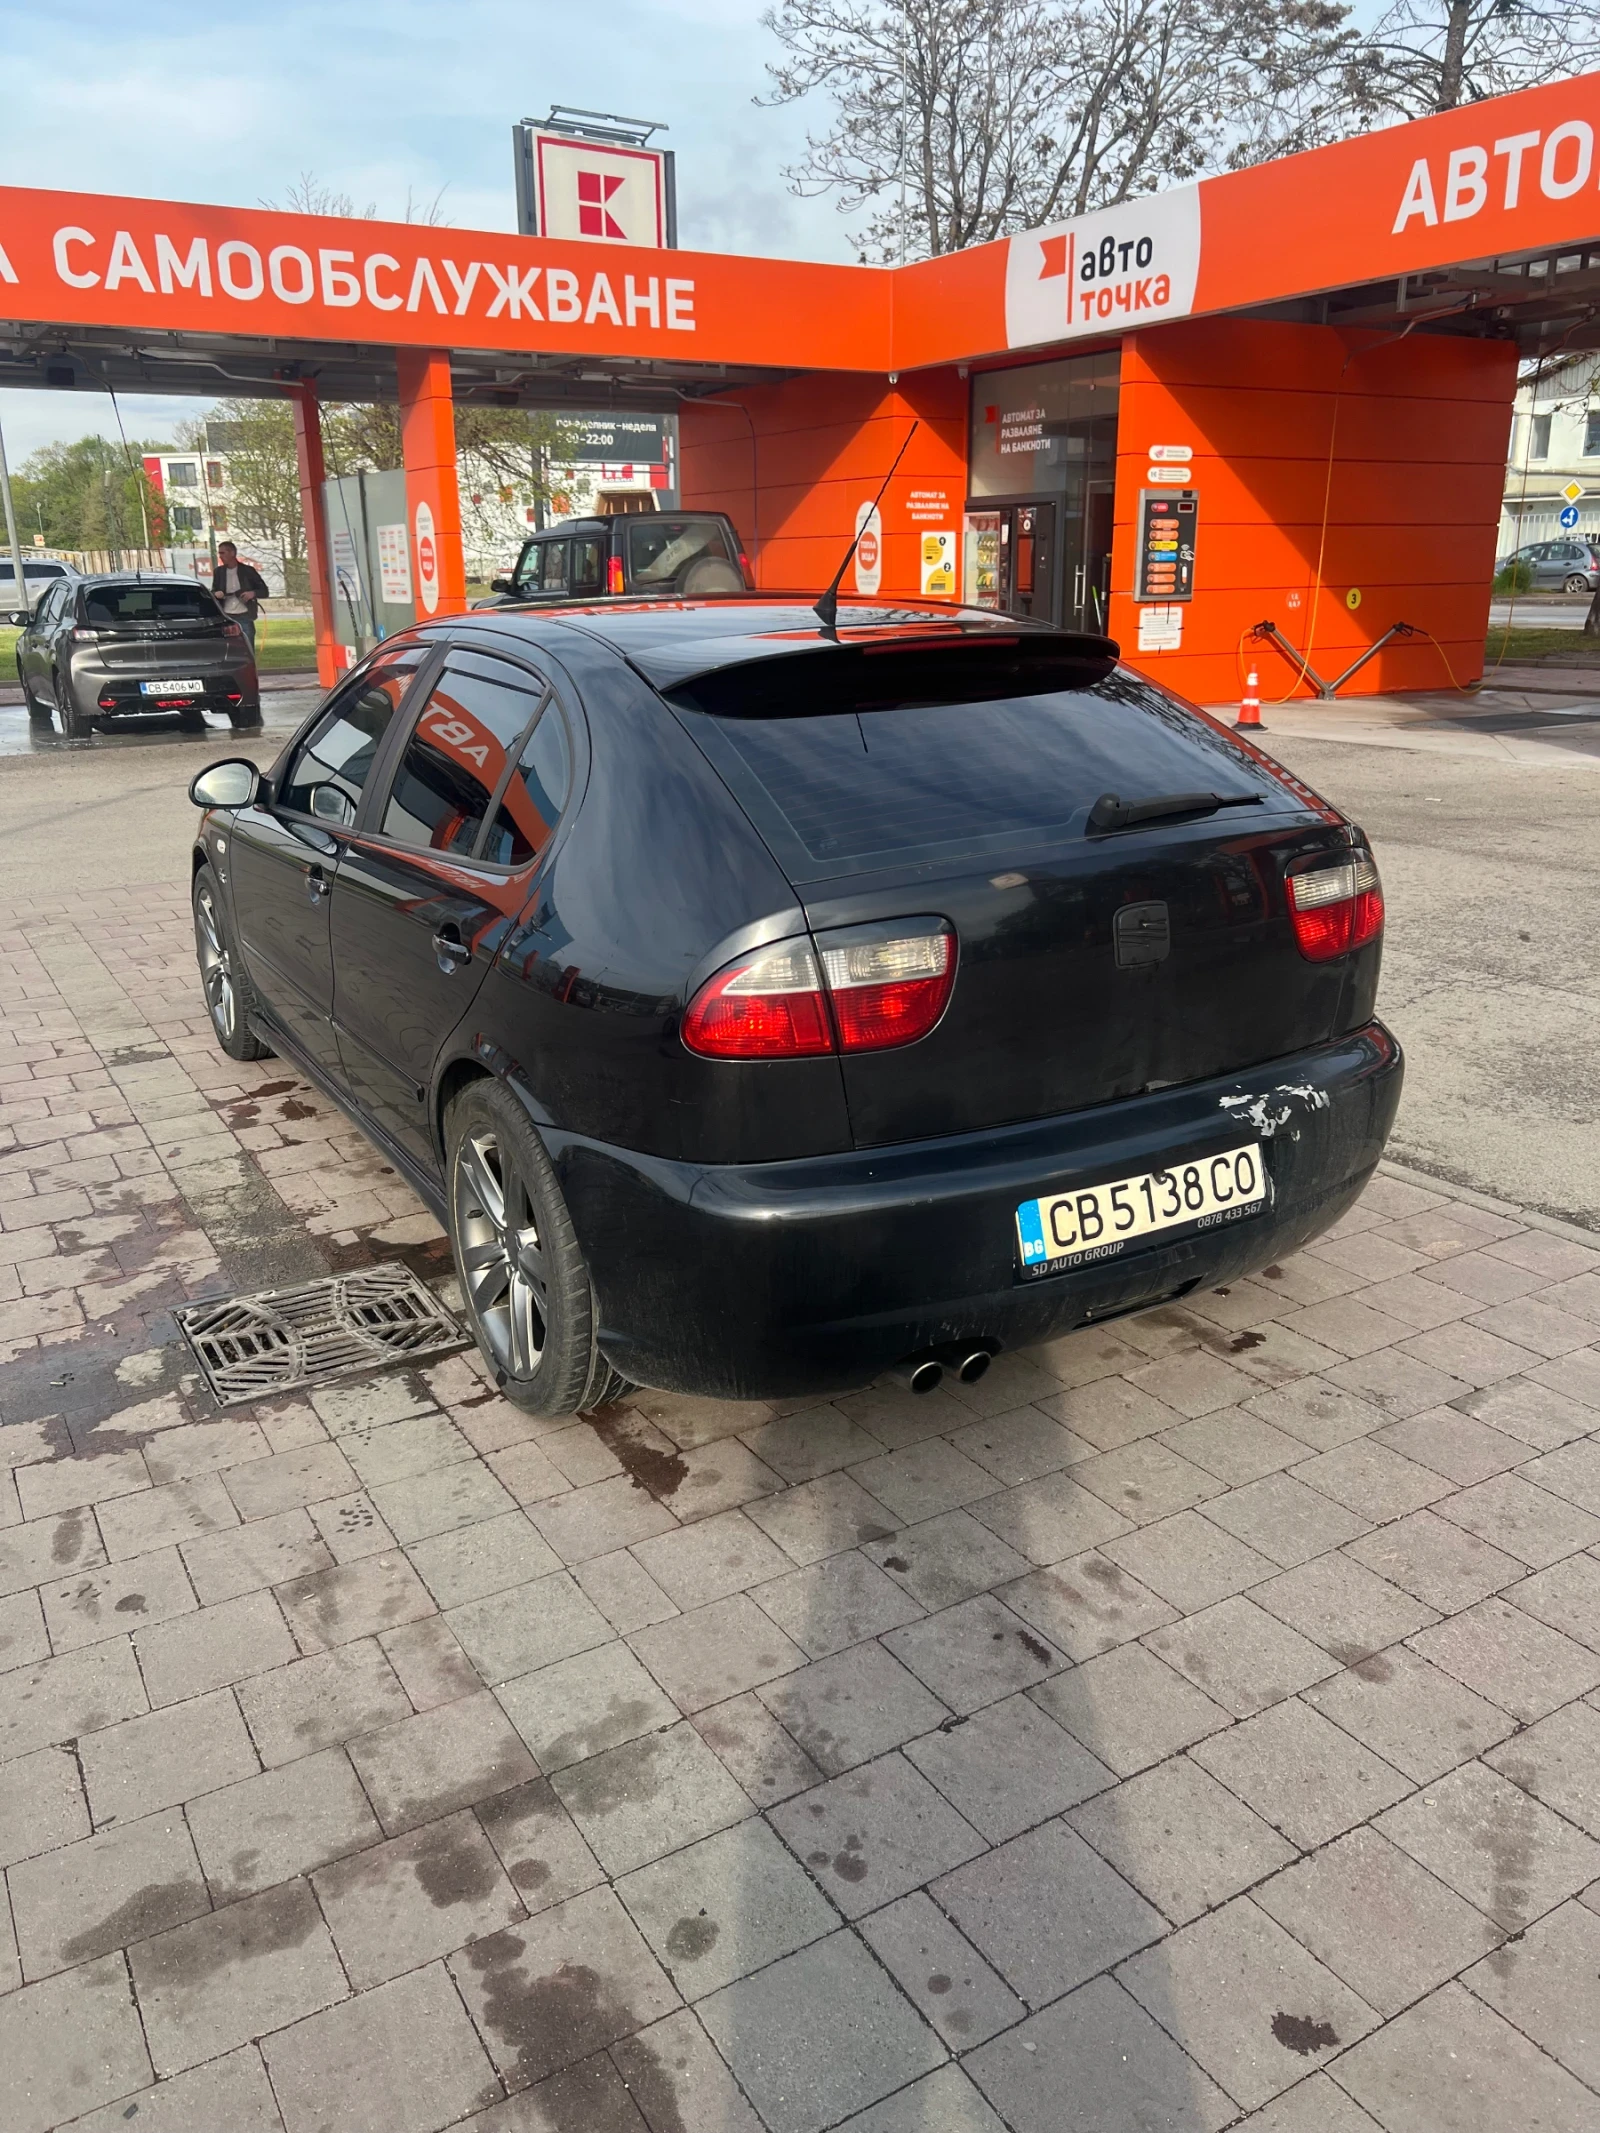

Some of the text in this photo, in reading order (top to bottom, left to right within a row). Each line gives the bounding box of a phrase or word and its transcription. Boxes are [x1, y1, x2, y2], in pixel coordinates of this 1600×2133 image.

[1391, 120, 1600, 235] АВТО
[1080, 236, 1153, 282] авто
[53, 226, 696, 331] САМООБСЛУЖВАНЕ
[1080, 273, 1171, 321] точка
[1002, 408, 1046, 424] АВТОМАТ ЗА
[1001, 424, 1043, 439] РАЗВАЛЯНЕ
[1001, 438, 1051, 454] НА БАНКНОТИ
[1351, 593, 1357, 604] 3
[148, 681, 201, 693] CB 5406 MO
[1049, 1151, 1256, 1247] CB 5138 CO
[1197, 1201, 1262, 1228] 0878 433 567
[1023, 1238, 1044, 1257] BG
[1031, 1241, 1124, 1276] SD AUTO GROUP
